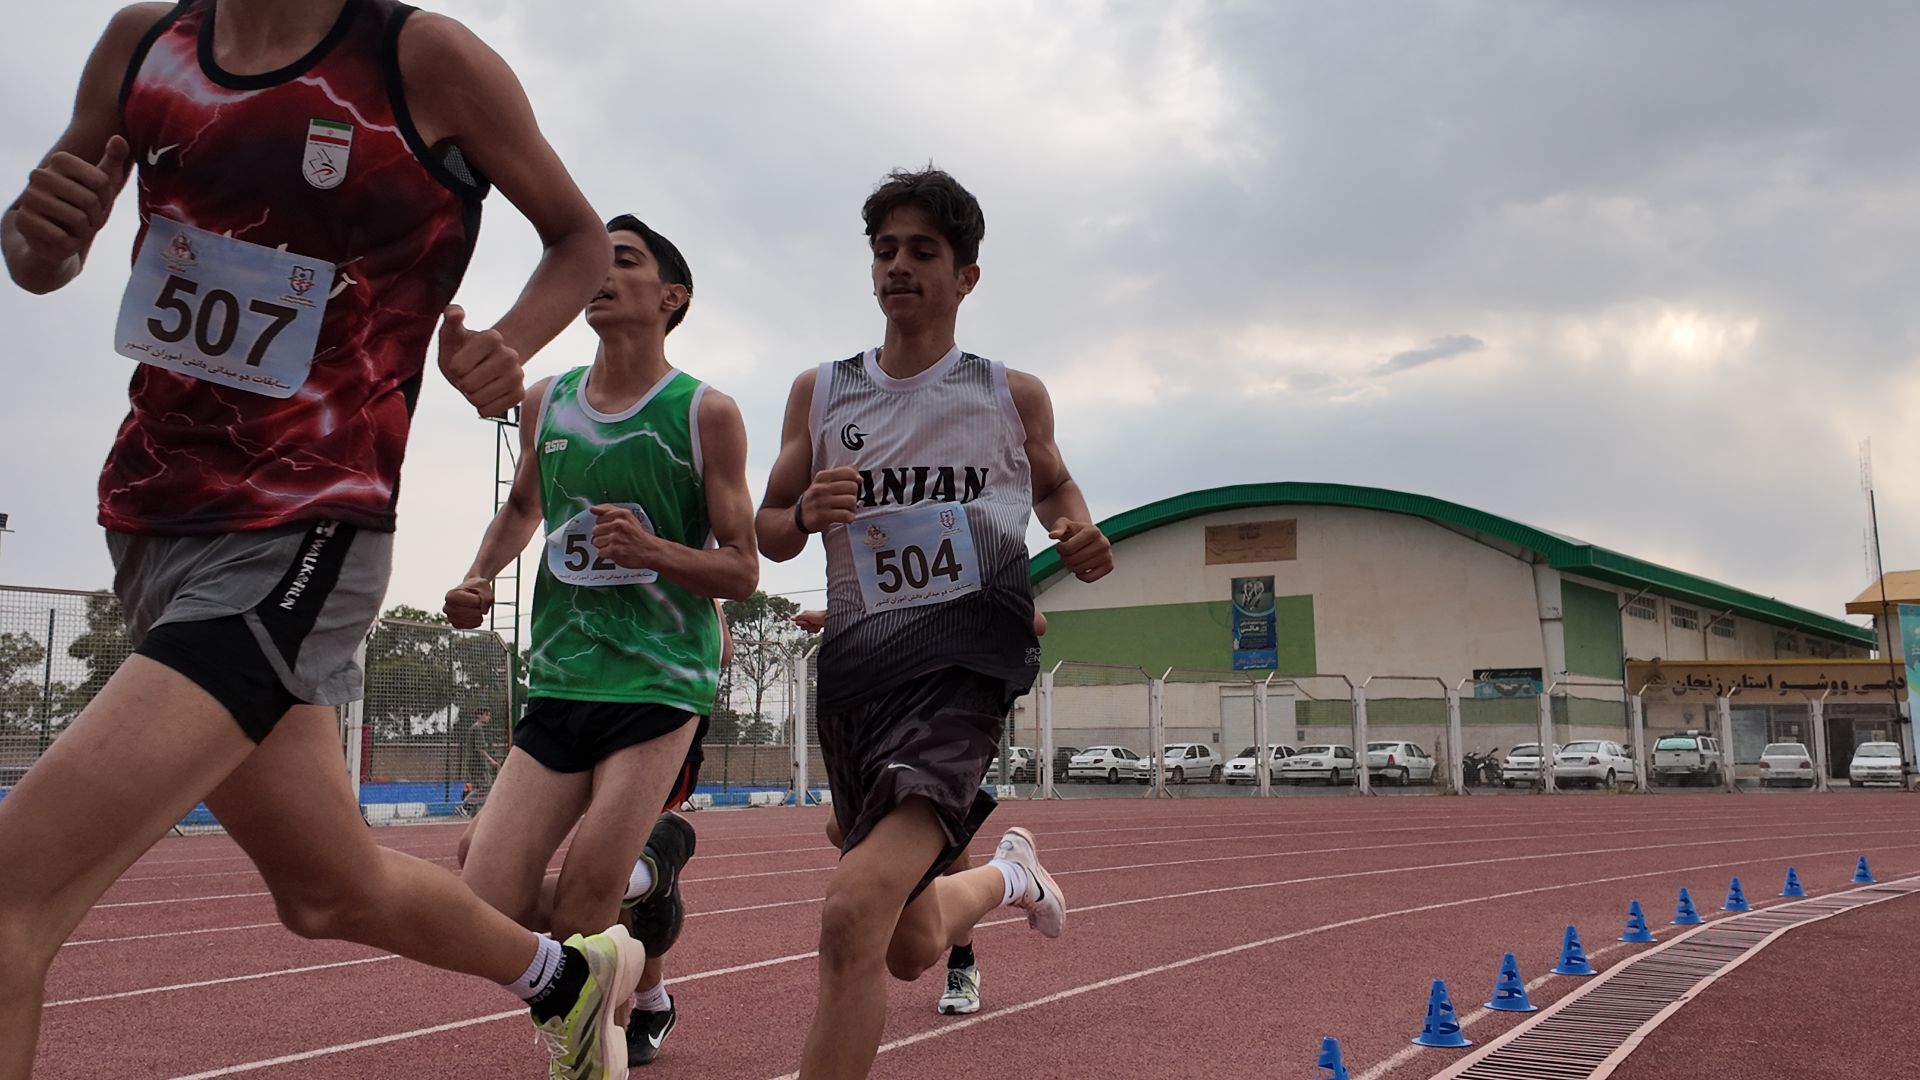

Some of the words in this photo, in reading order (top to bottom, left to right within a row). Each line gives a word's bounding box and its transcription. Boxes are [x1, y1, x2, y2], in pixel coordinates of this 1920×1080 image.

[147, 275, 298, 367] 507
[124, 343, 152, 351] کشور
[182, 359, 207, 369] دانش
[207, 366, 237, 377] میدانی
[252, 376, 291, 389] مسابقات
[857, 466, 989, 508] ANIAN
[875, 539, 963, 593] 504
[1672, 673, 1723, 697] زنجان
[1728, 673, 1773, 697] استان
